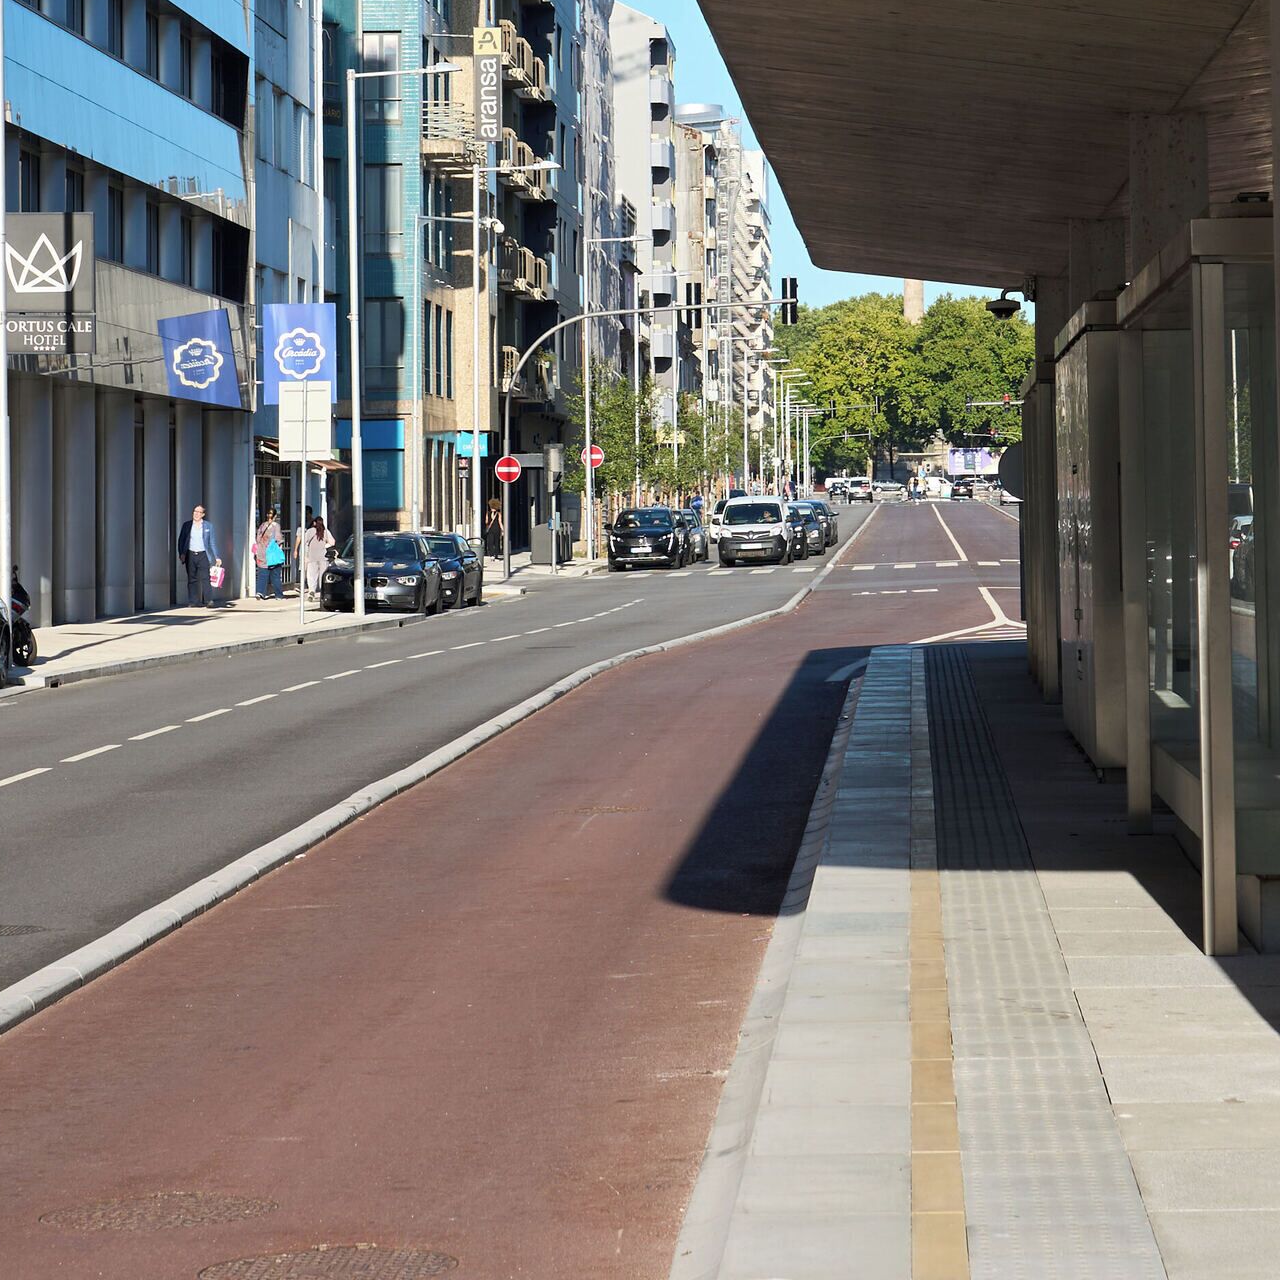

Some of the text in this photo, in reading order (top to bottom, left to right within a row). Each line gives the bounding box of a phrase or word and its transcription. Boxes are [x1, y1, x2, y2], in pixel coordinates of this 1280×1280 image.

[481, 58, 497, 138] aransa
[6, 321, 92, 332] ORTUS CALE
[24, 334, 67, 346] HOTEL
